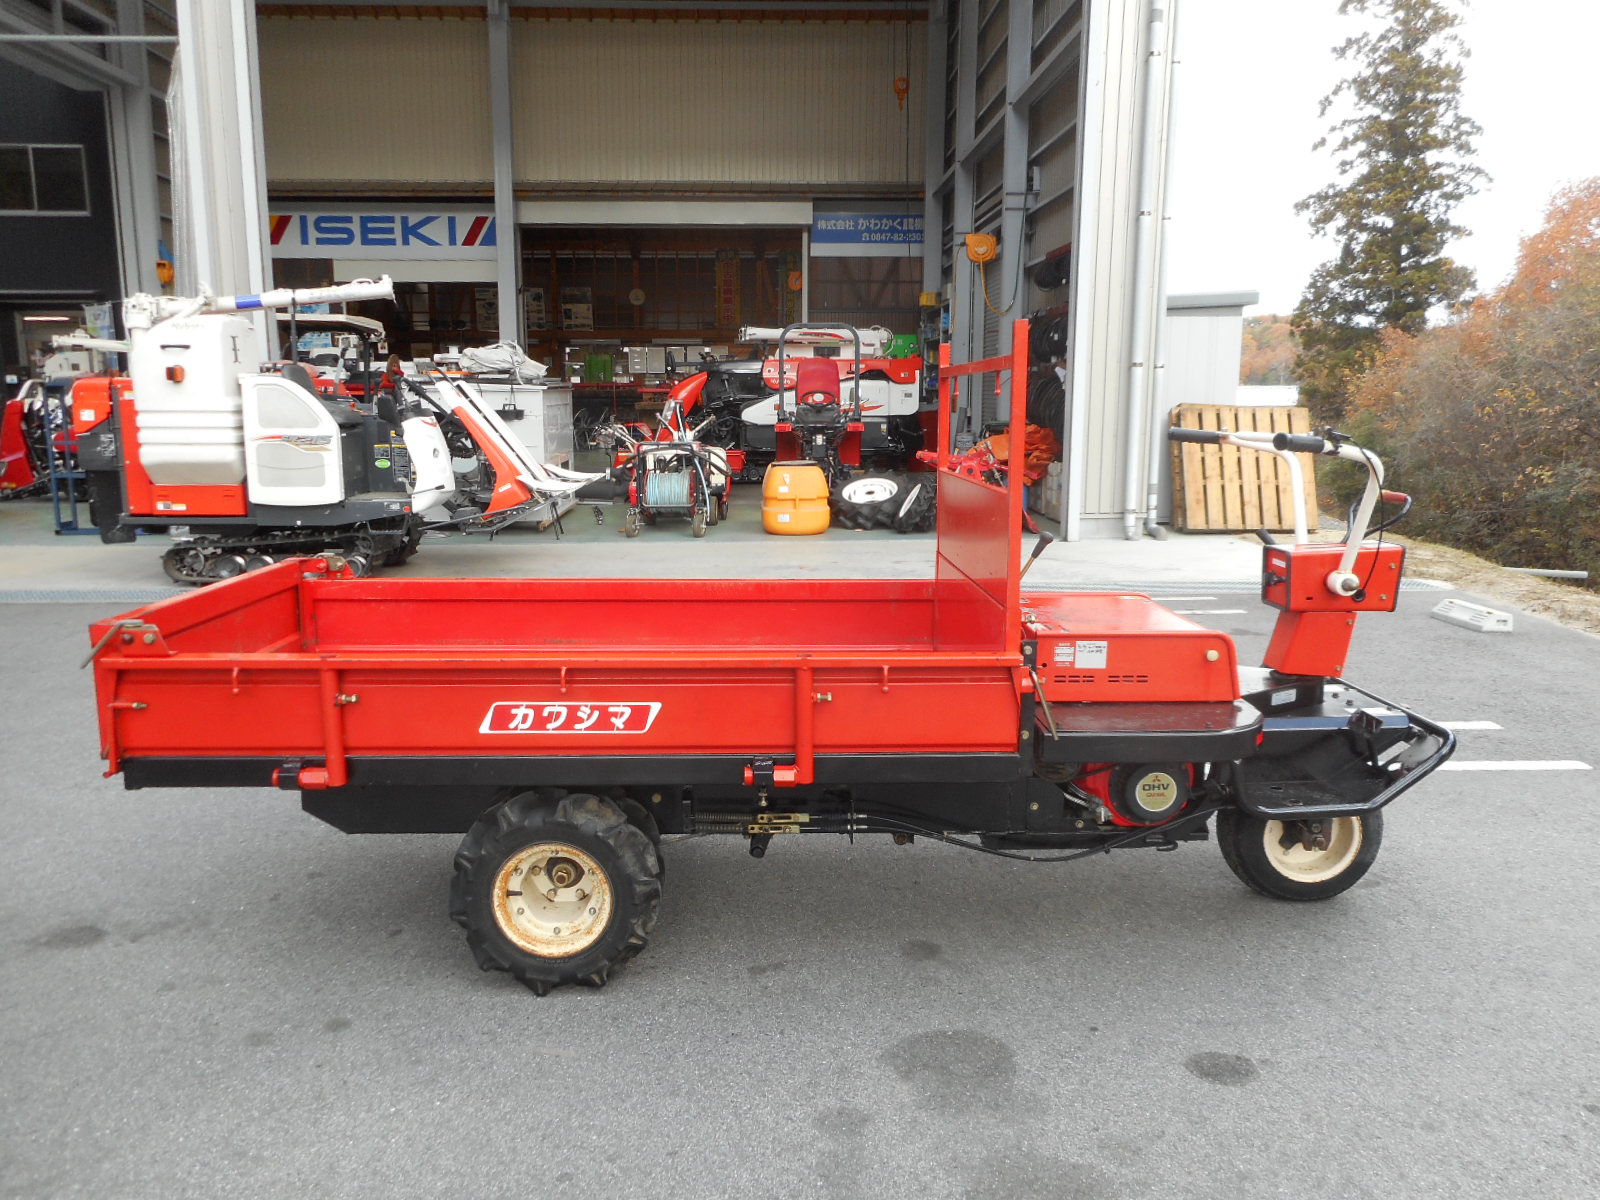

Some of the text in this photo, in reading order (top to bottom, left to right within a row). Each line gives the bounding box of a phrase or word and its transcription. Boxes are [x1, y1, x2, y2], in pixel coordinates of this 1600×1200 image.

[299, 215, 458, 246] ISEKI
[818, 219, 855, 231] 株式会社
[508, 705, 633, 730] カワシマ
[1142, 783, 1170, 791] OHV
